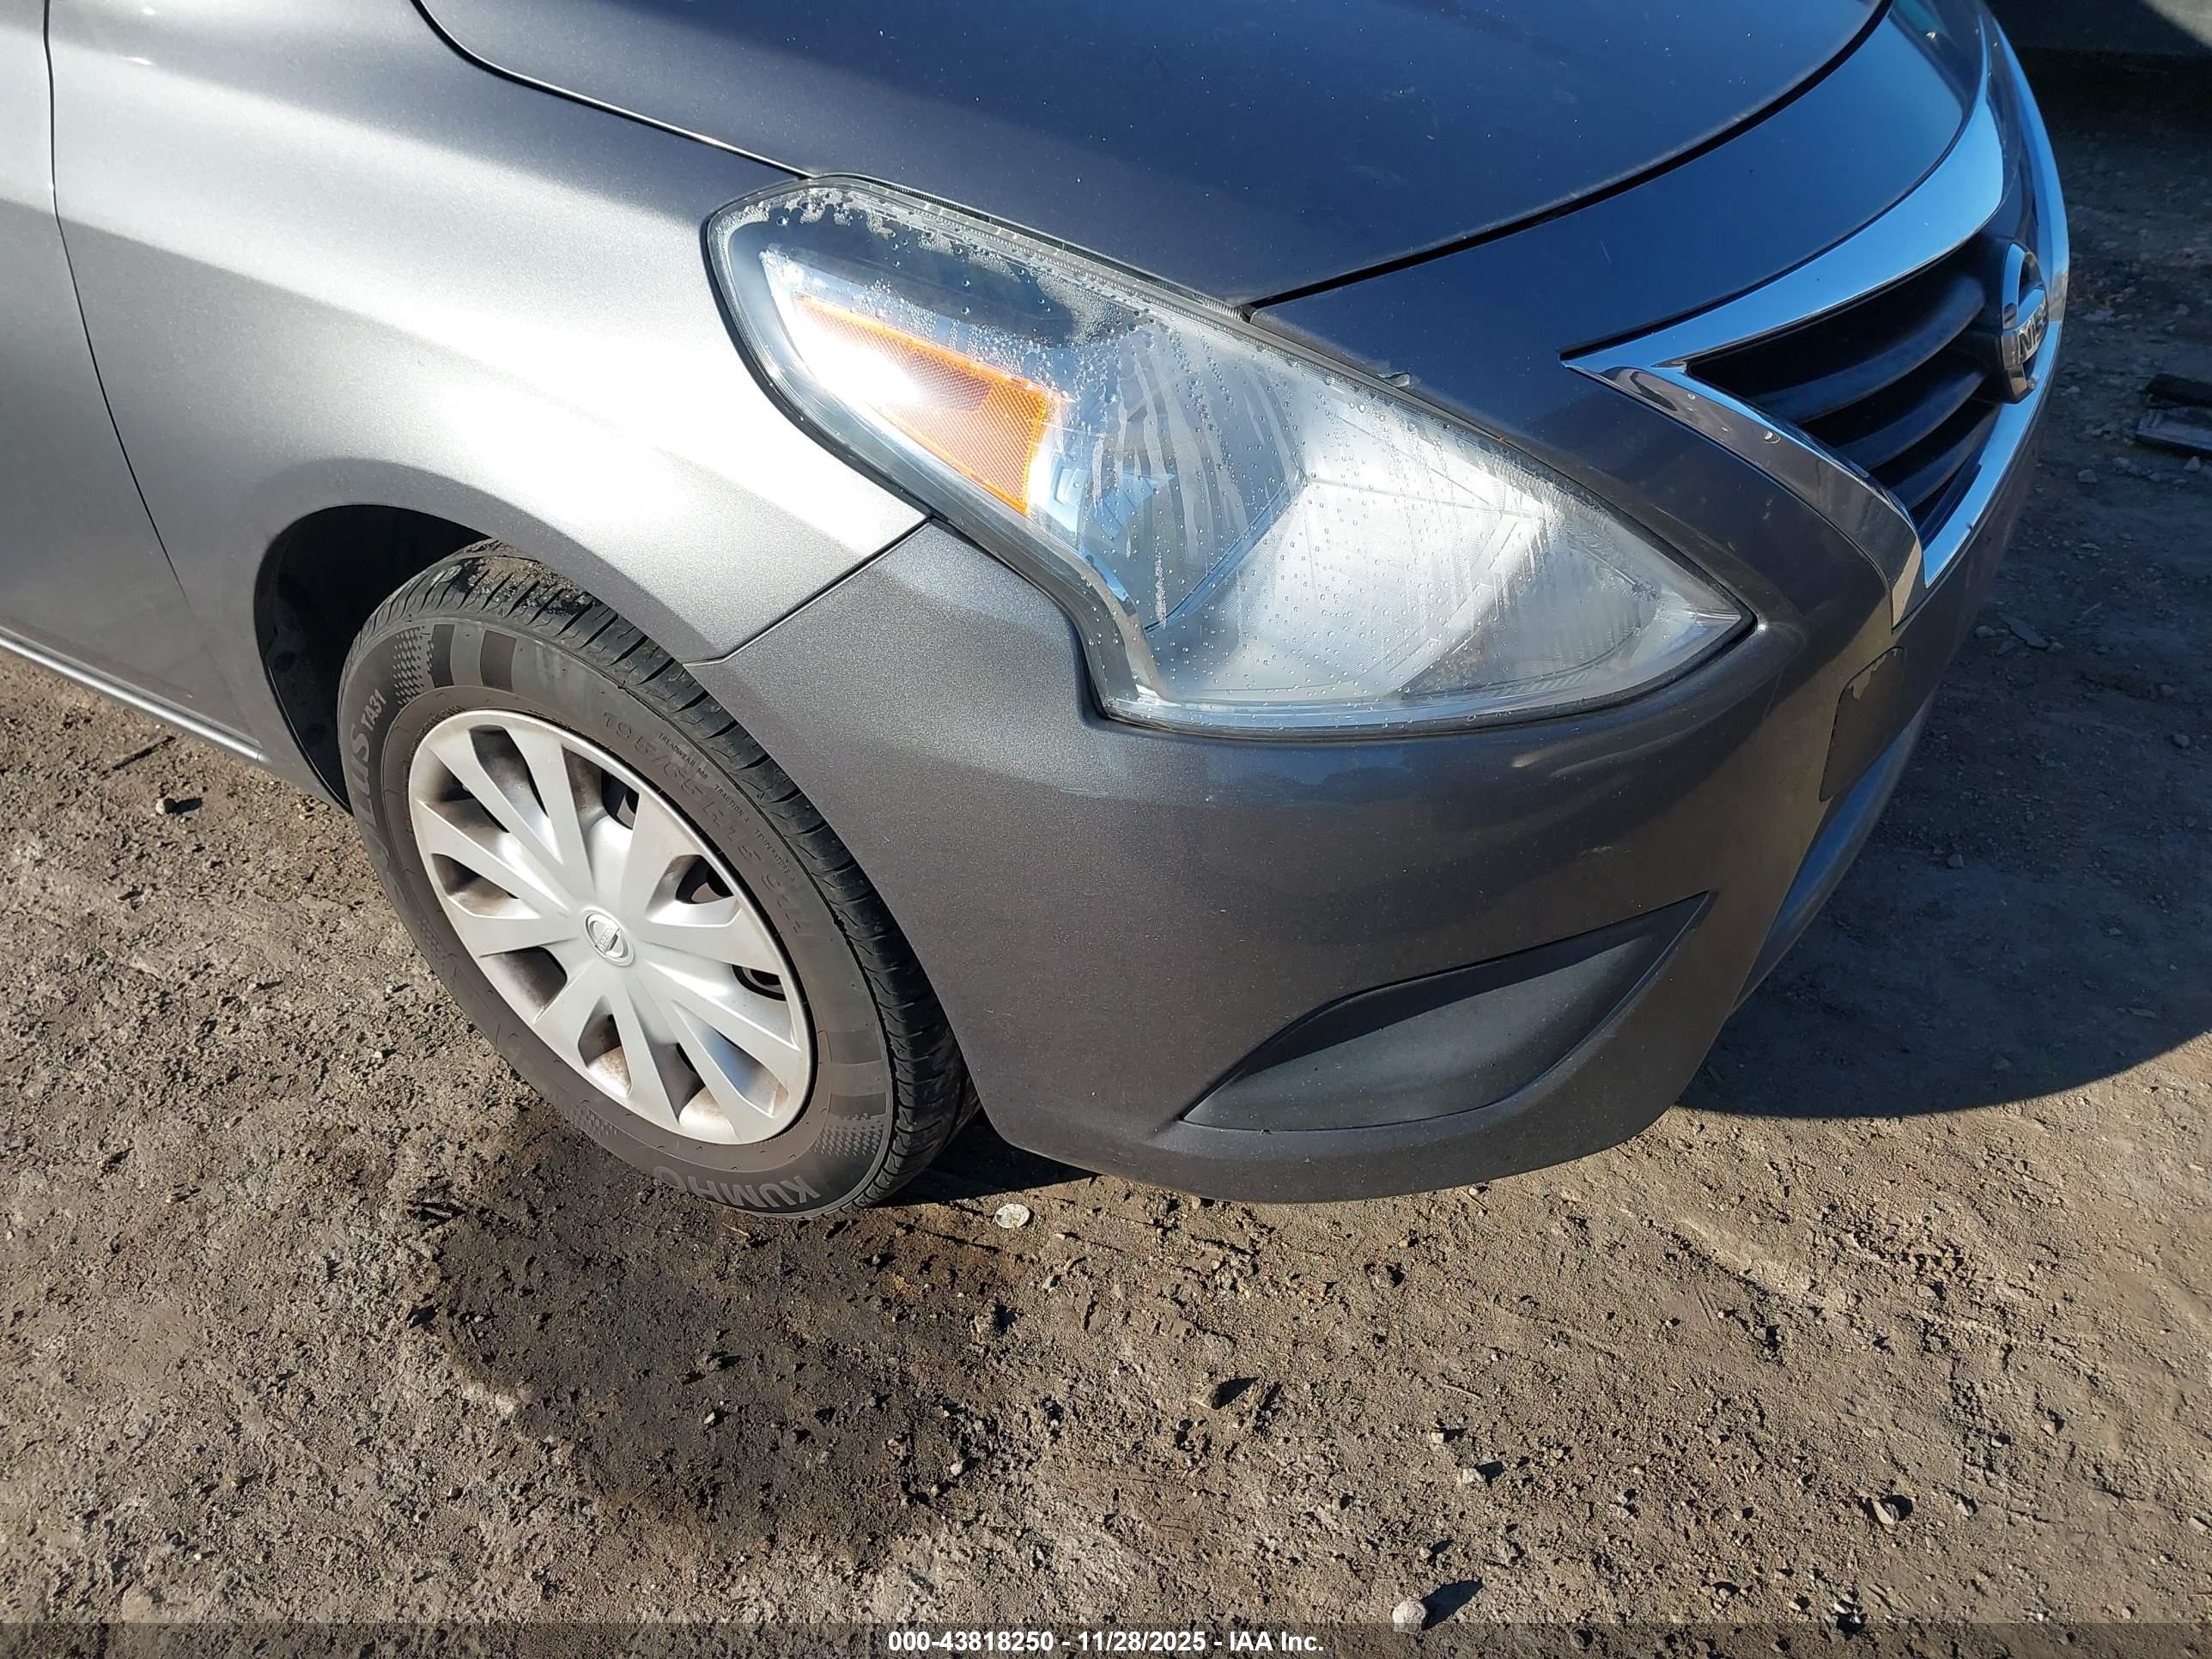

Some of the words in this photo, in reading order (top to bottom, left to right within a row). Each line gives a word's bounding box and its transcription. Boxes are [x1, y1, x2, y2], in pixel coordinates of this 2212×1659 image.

[361, 689, 386, 732] TA31
[659, 732, 696, 768] TREADWEAR
[714, 783, 744, 817] TRACTION
[754, 828, 791, 875] TEMPERATURE
